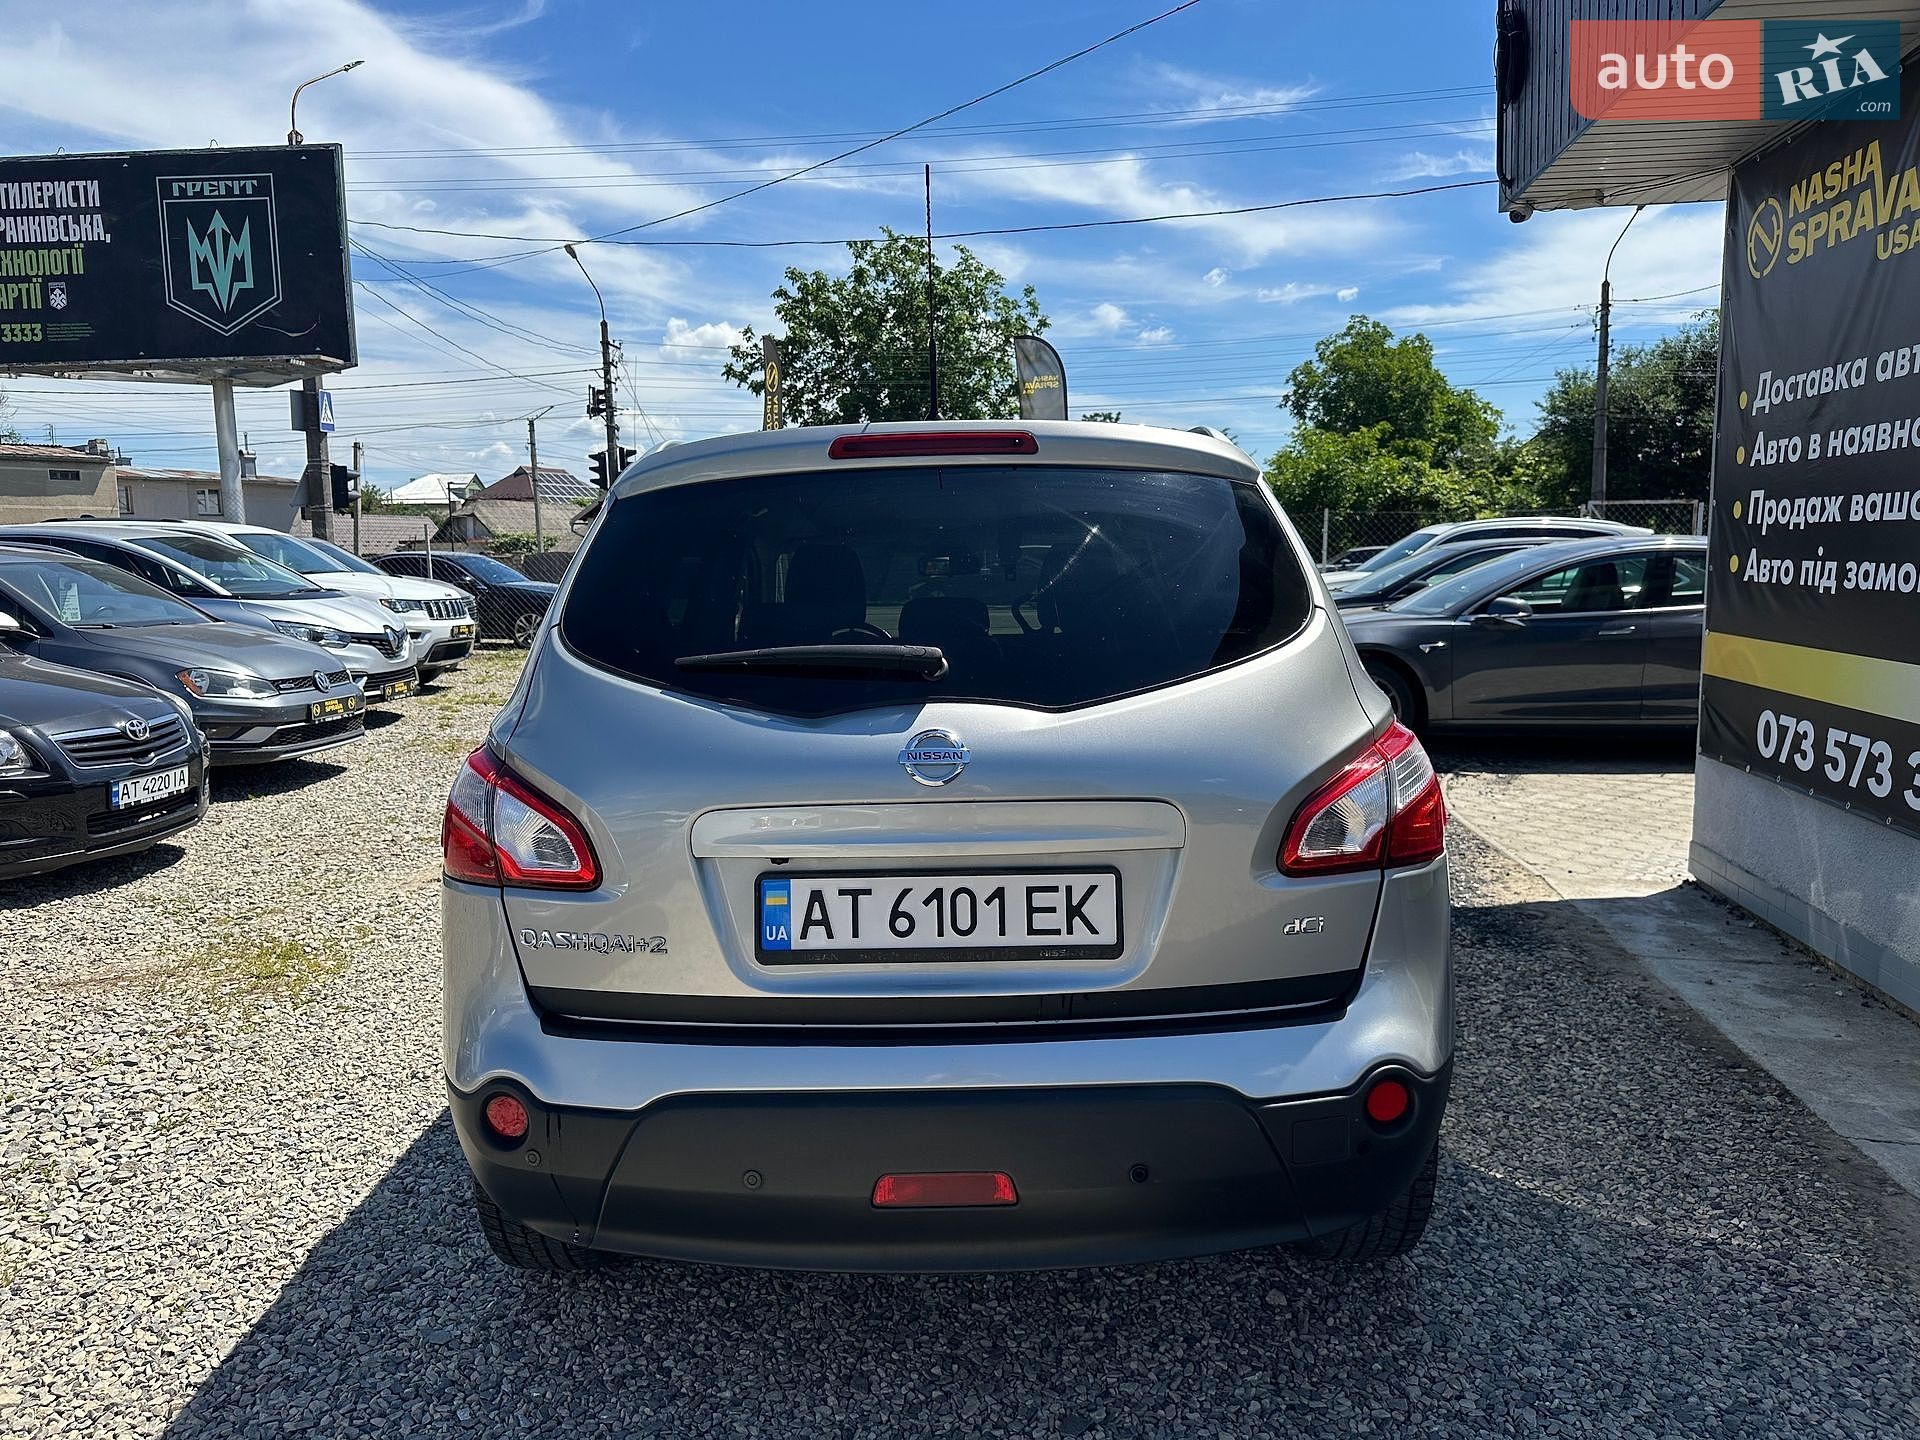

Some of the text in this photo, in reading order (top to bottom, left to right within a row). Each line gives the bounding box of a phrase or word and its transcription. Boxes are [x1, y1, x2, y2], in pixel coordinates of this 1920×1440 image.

[1788, 139, 1882, 219] NASHA
[1786, 166, 1920, 264] SPRAVA
[1877, 217, 1920, 260] USA
[0, 243, 84, 276] ХНОЛОГІЇ
[1, 323, 43, 342] 3333
[1752, 357, 1868, 416] Доставка
[1749, 431, 1802, 467] Авто
[1807, 433, 1821, 460] в
[1747, 489, 1845, 536] Продаж
[1743, 546, 1920, 594] Авто під замо
[906, 751, 964, 762] NISSAN
[1756, 709, 1815, 772] 073
[1824, 728, 1893, 798] 573
[120, 780, 141, 802] AT
[142, 773, 171, 795] 4220
[173, 769, 186, 788] IA
[799, 884, 1100, 940] AT 6101 EK
[1283, 915, 1325, 936] dCi
[520, 928, 668, 955] QASHQAI+2
[766, 926, 789, 942] UA
